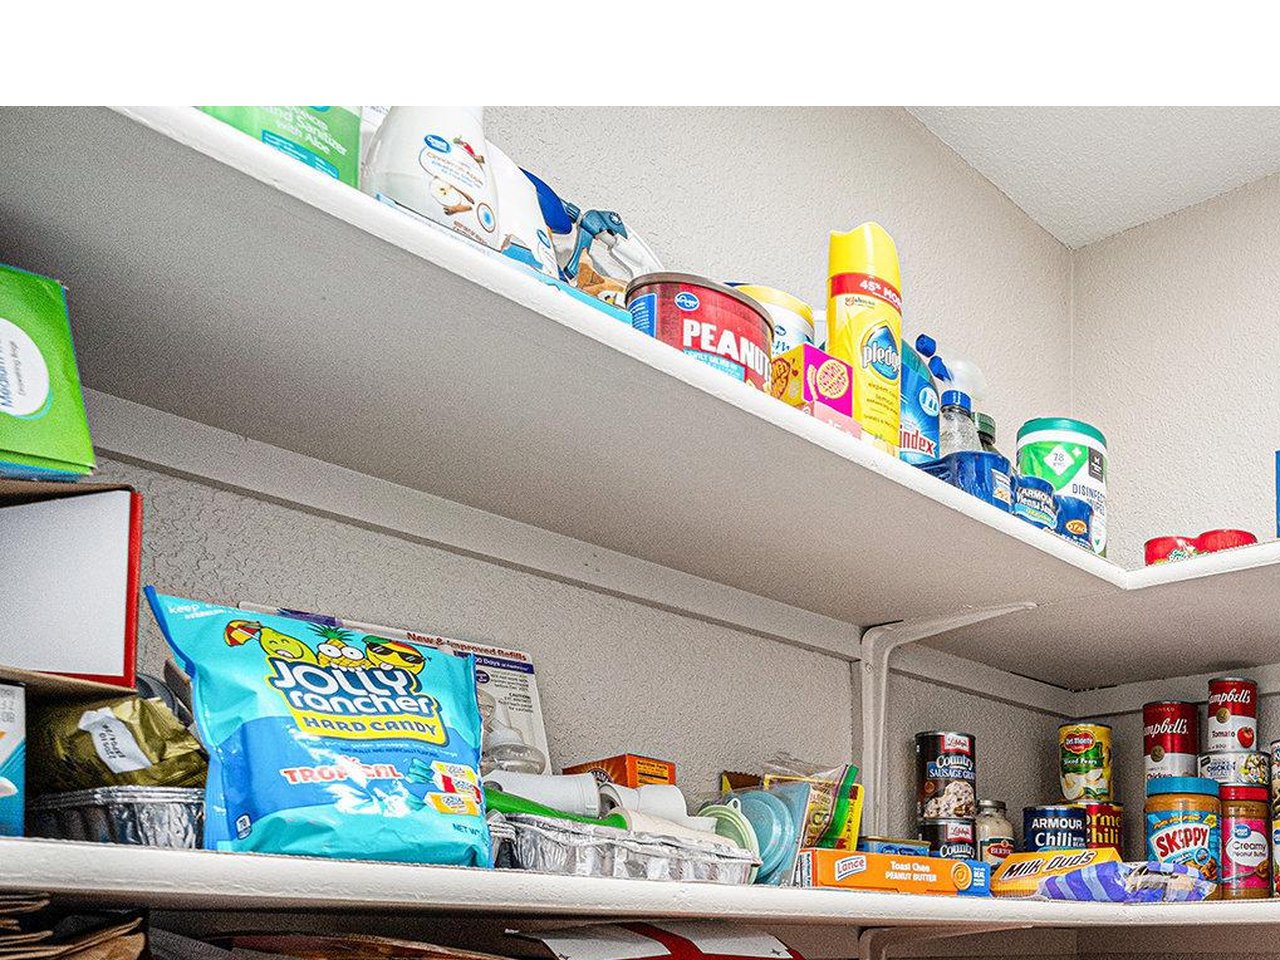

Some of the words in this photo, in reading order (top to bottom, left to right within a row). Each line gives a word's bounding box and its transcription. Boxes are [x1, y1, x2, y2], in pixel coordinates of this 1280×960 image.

[900, 426, 934, 454] index
[407, 632, 434, 643] New
[498, 650, 526, 661] Refills
[273, 661, 410, 697] JOLLY
[288, 689, 436, 715] rancher
[304, 716, 367, 733] HARD
[371, 719, 438, 736] CANDY
[936, 755, 974, 769] Country
[1032, 818, 1083, 830] ARMOUR
[1034, 832, 1072, 847] Chili
[1156, 829, 1208, 857] SKIPPY
[1233, 841, 1267, 851] Creamy
[838, 857, 865, 874] Lance
[1001, 859, 1044, 881] Milk
[1045, 851, 1097, 872] Duds
